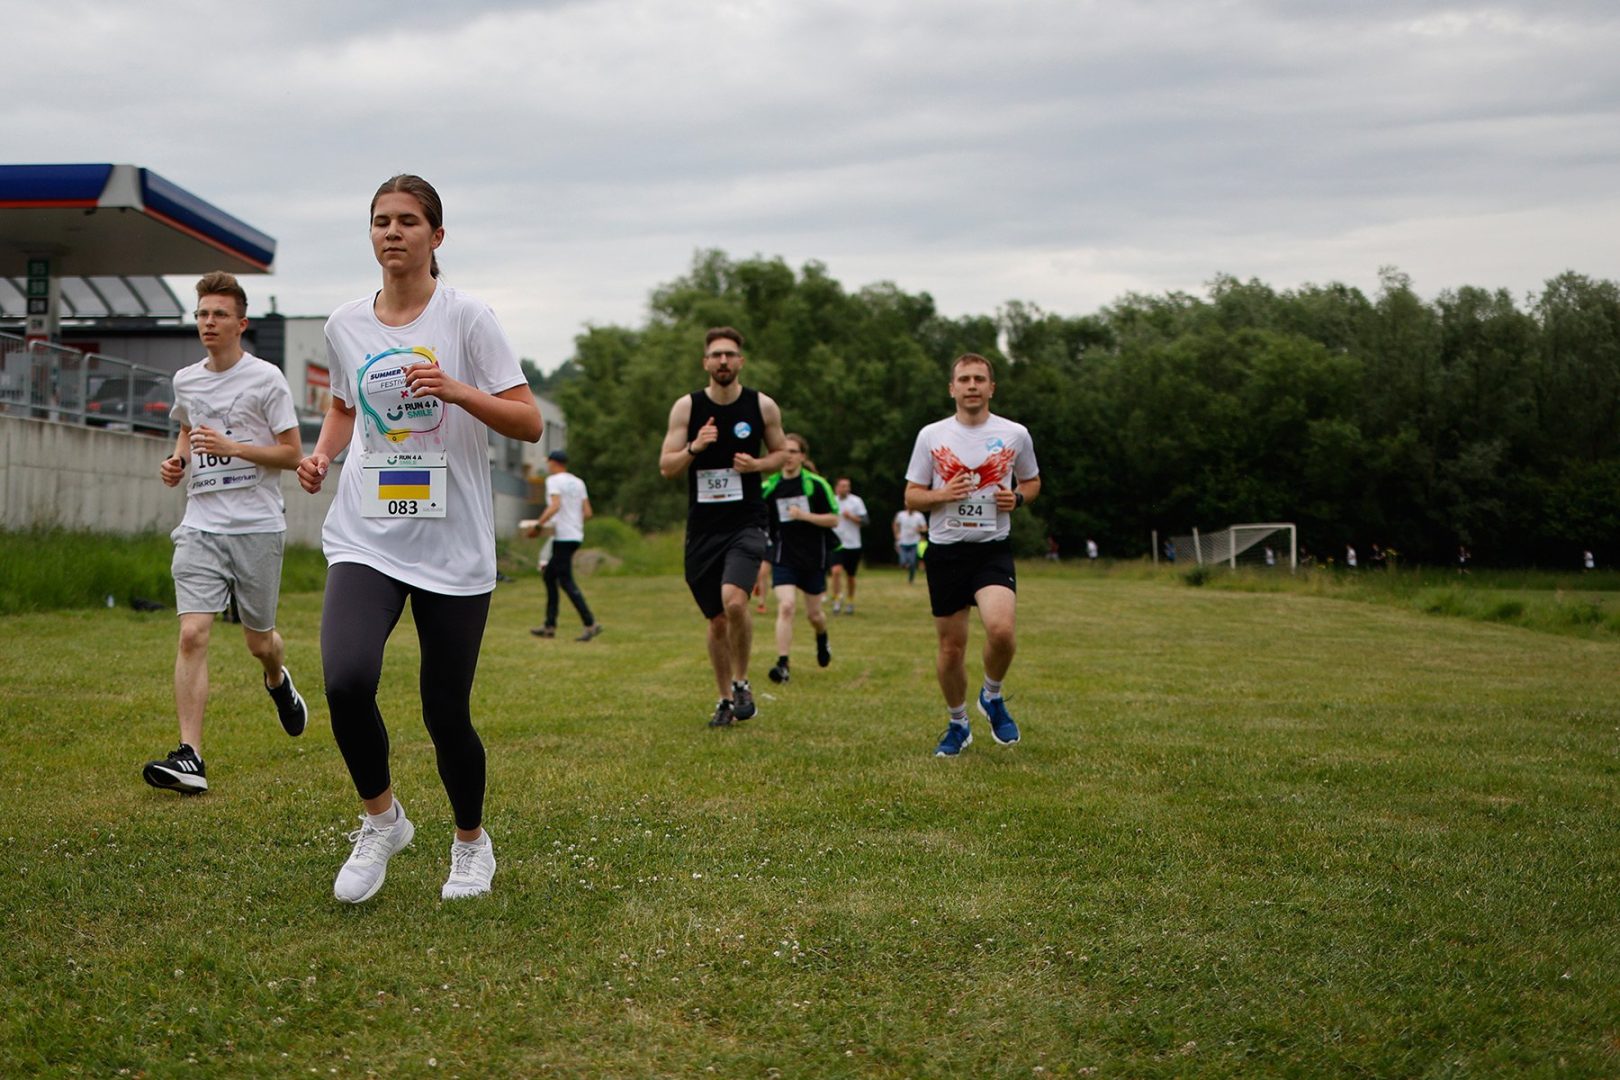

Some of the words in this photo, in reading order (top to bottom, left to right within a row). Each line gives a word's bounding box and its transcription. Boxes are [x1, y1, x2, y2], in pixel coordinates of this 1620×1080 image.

[370, 368, 402, 380] SUMMER
[405, 402, 424, 411] RUN
[425, 400, 431, 408] 4
[432, 399, 439, 408] A
[407, 409, 433, 419] SMILE
[707, 478, 729, 490] 587
[388, 500, 418, 515] 083
[958, 504, 983, 517] 624
